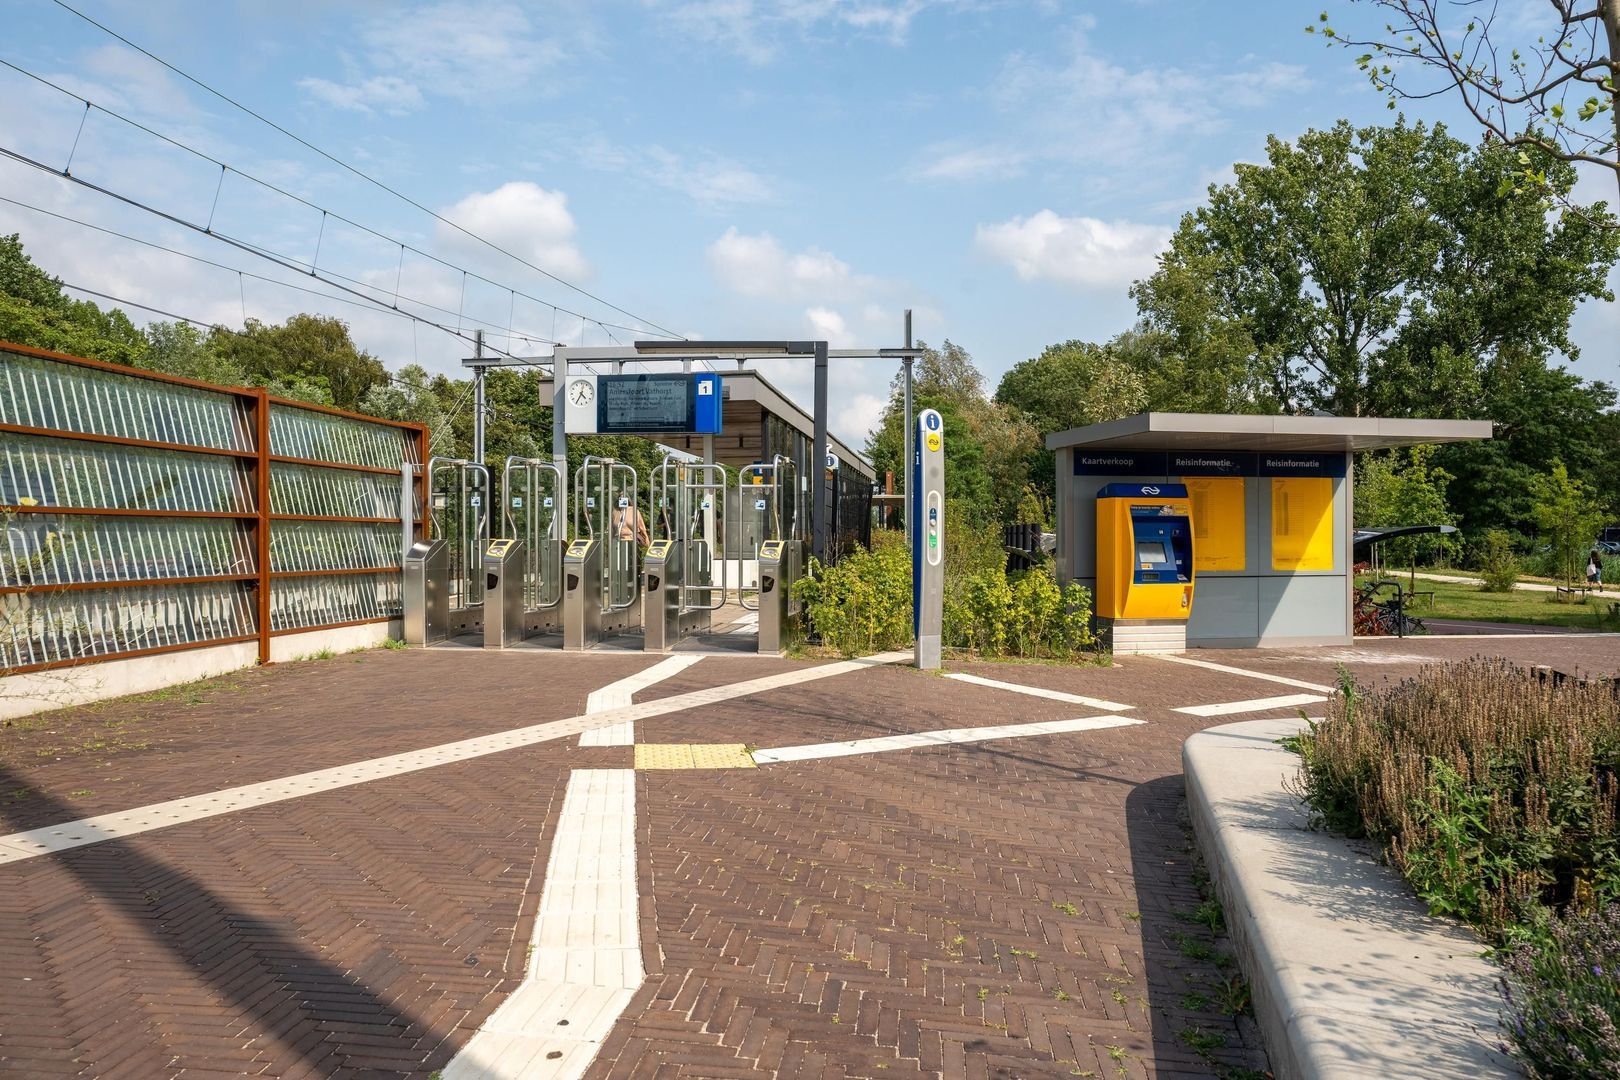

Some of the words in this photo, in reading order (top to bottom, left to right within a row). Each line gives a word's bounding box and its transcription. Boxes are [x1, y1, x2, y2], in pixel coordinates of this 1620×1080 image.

[703, 385, 707, 394] 1
[1081, 457, 1134, 467] Kaartverkoop
[1175, 458, 1231, 467] Reisinformatie
[1266, 459, 1320, 468] Reisinformatie
